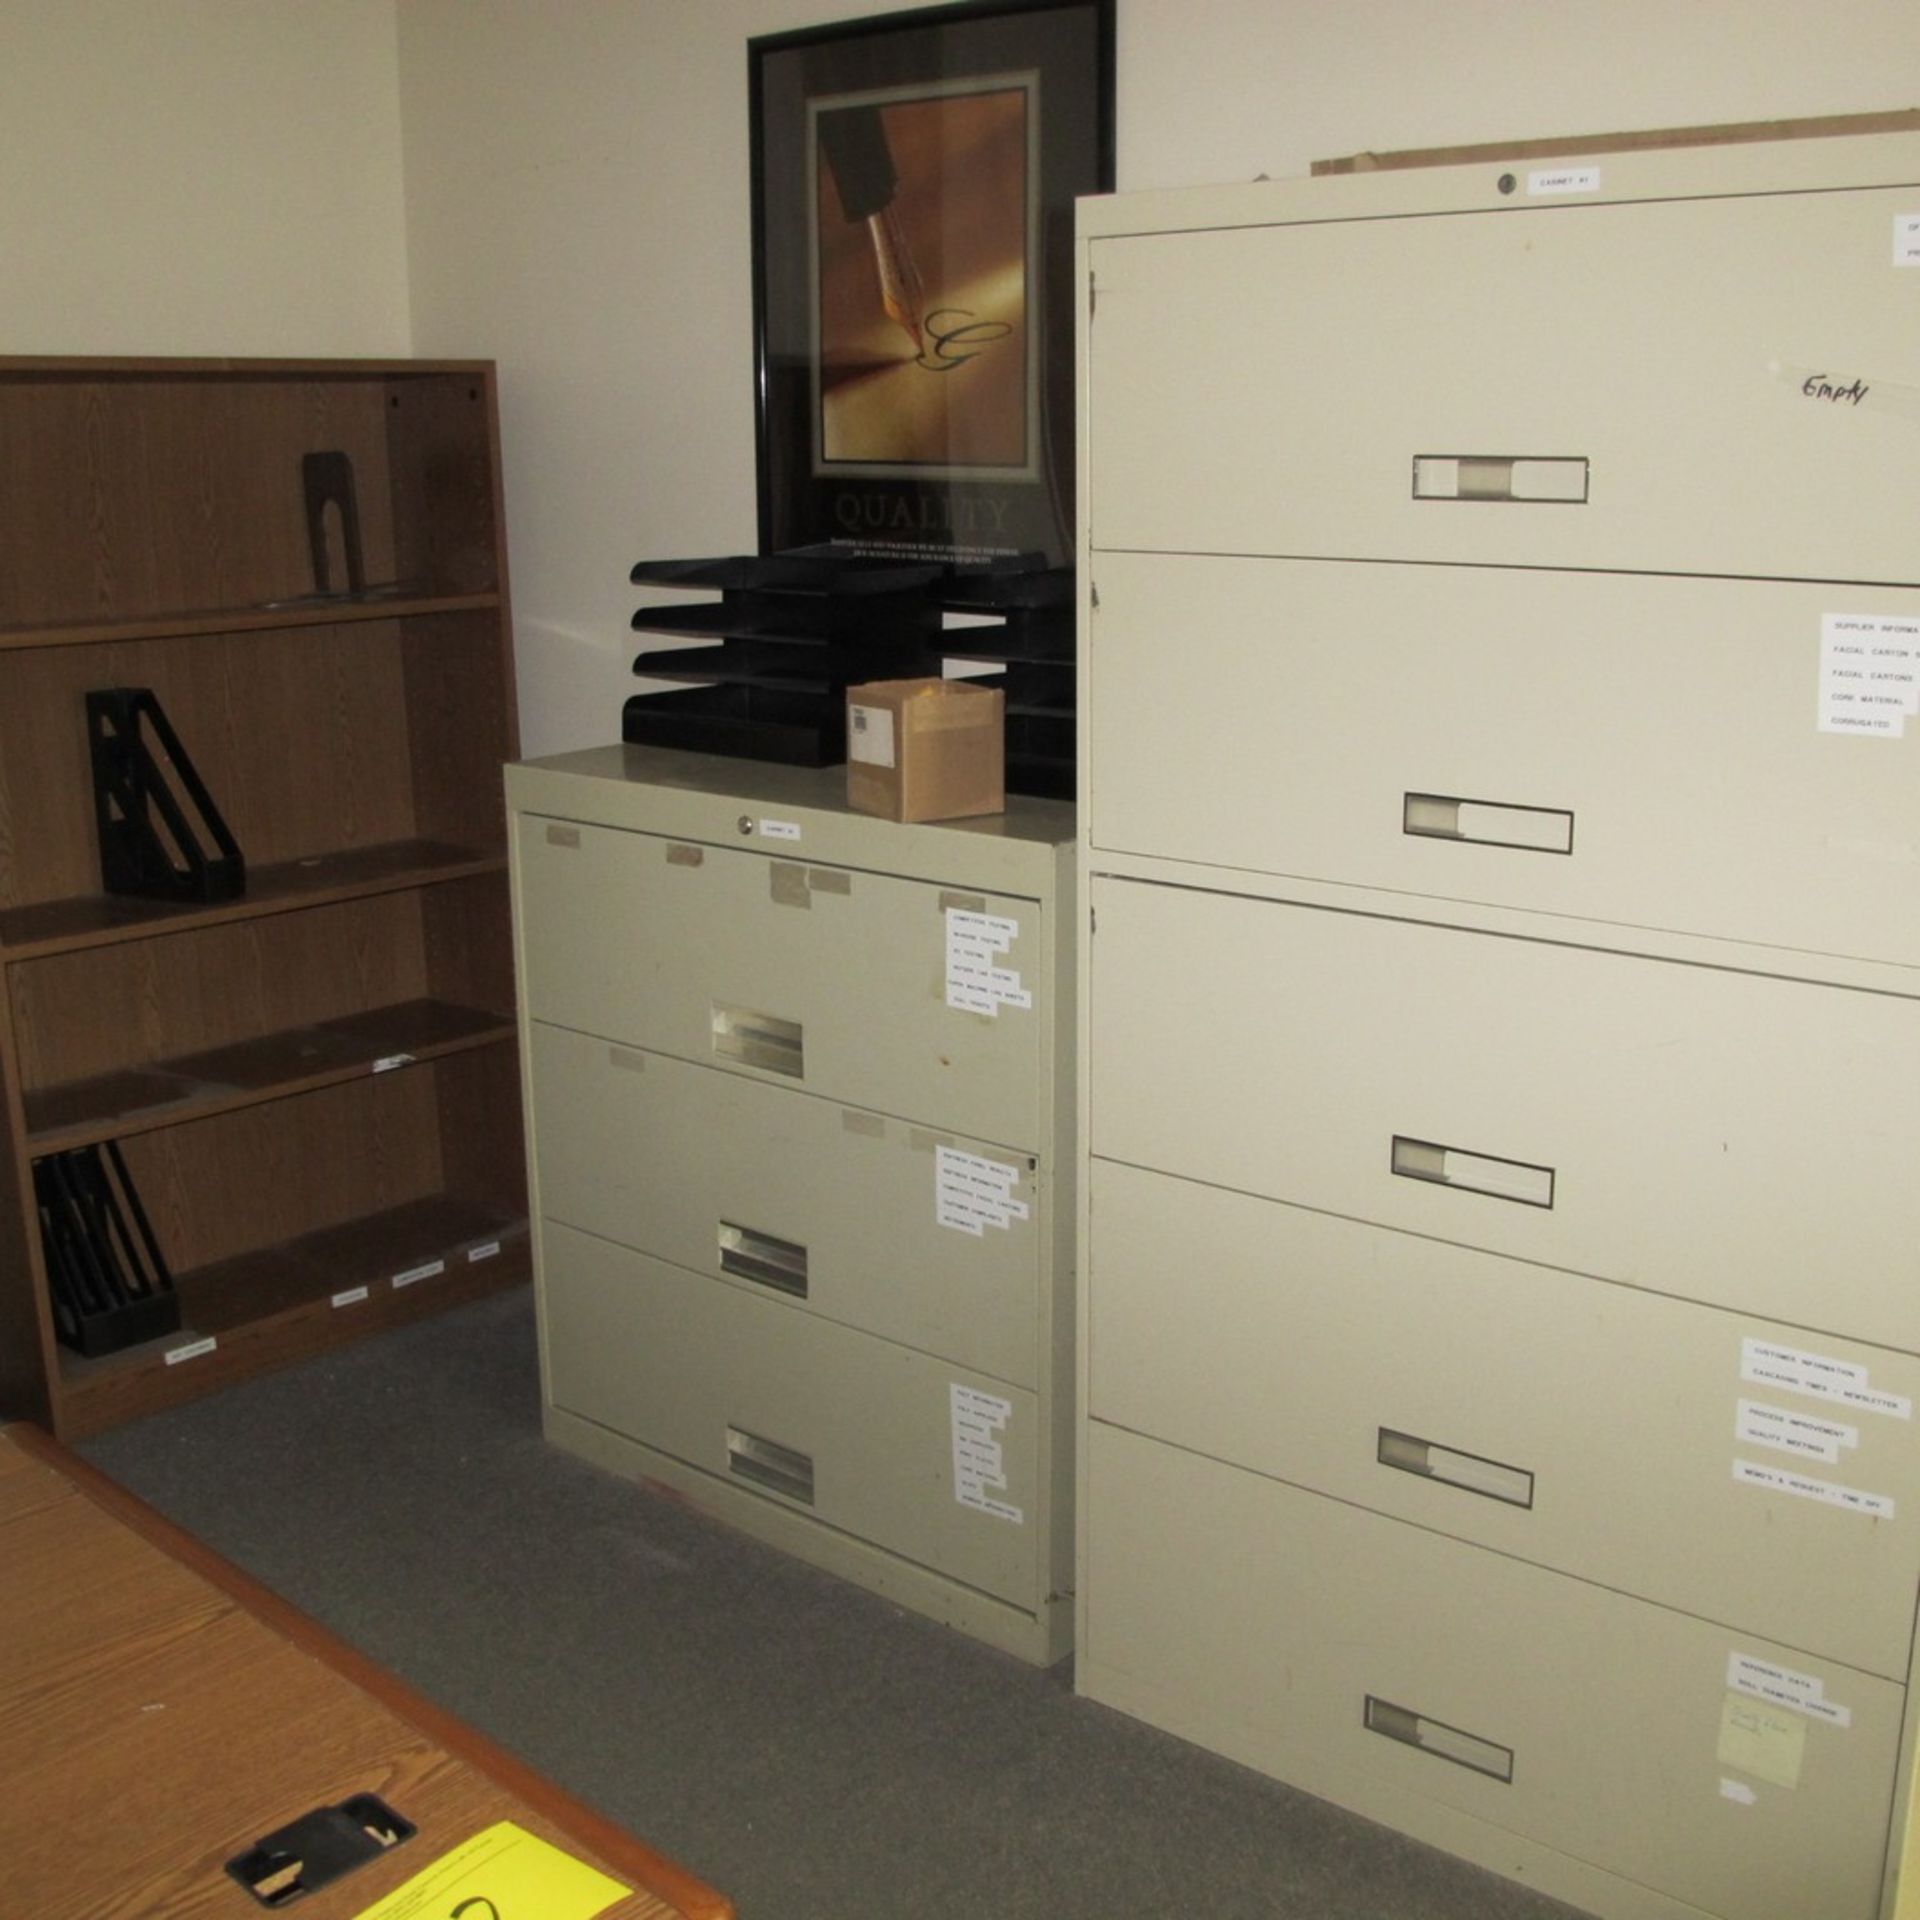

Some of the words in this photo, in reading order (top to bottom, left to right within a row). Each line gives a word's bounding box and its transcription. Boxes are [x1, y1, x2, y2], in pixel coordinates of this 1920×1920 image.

[1802, 374, 1869, 406] Empty
[834, 494, 1011, 532] QUALITY
[1834, 622, 1875, 631] SUPPLIER
[1833, 646, 1865, 656] FACIAL
[1871, 648, 1909, 658] CARTON
[1832, 669, 1863, 679] FACIAL
[1870, 672, 1913, 682] CARTONS
[1831, 693, 1855, 701] CORE
[1860, 696, 1905, 706] MATERIAL
[1830, 717, 1890, 728] CORRUGATED
[1754, 1347, 1797, 1363] CUSTOMER
[1801, 1359, 1857, 1378] INFORMATION
[1842, 1391, 1900, 1410] NEWSLETTER
[1748, 1408, 1785, 1423] PROCESS
[1789, 1419, 1846, 1438] IMPROVEMENT
[1747, 1428, 1782, 1442] QUALITY
[1786, 1438, 1826, 1454] MEETINGS
[1788, 1676, 1812, 1689] DATA
